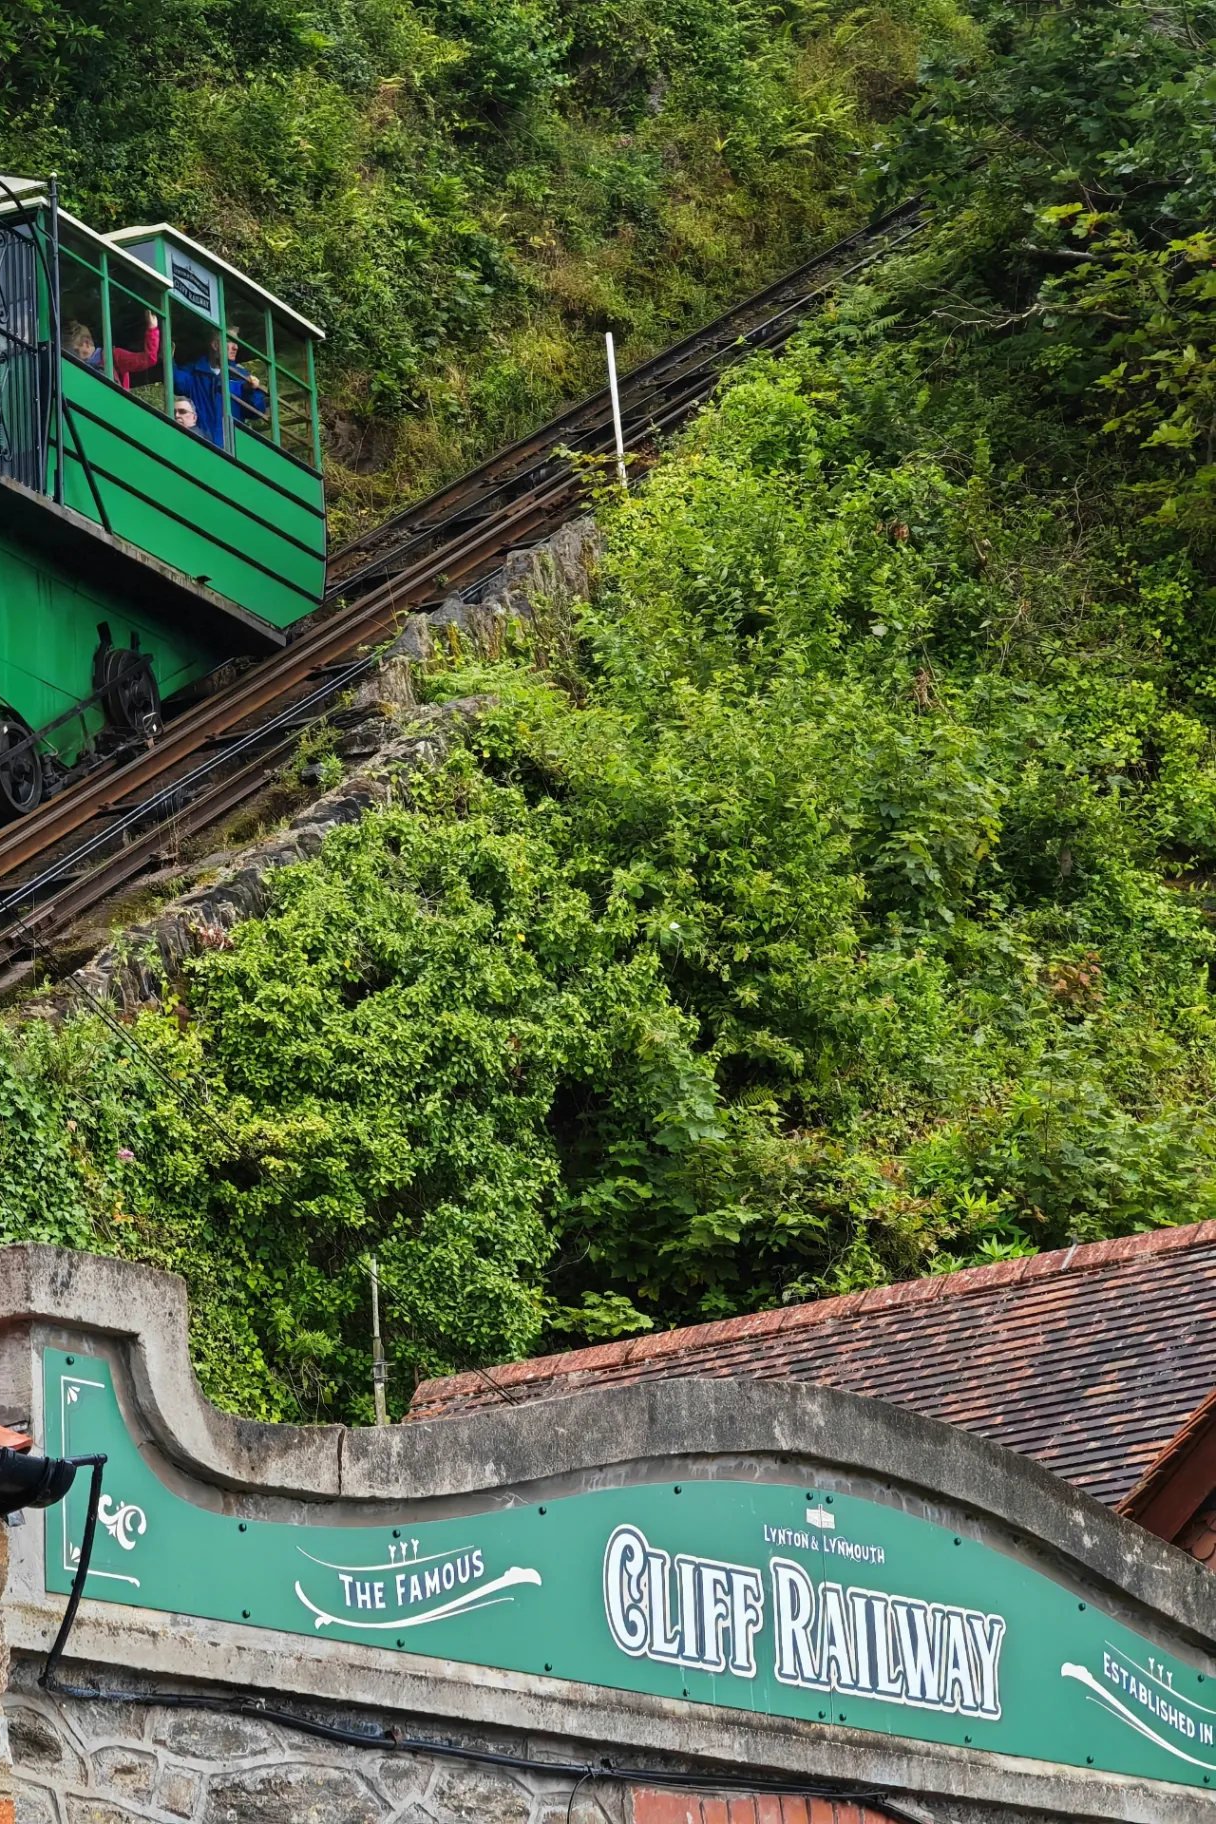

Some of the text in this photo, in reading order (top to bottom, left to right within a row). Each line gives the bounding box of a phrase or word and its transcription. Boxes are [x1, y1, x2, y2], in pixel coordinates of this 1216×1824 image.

[338, 1548, 485, 1609] THE FAMOUS
[763, 1523, 885, 1564] LYNTON & LYNMOUTH
[603, 1524, 1006, 1721] CLIFF RAILWAY
[1103, 1650, 1214, 1746] ESTABLISHED IN
